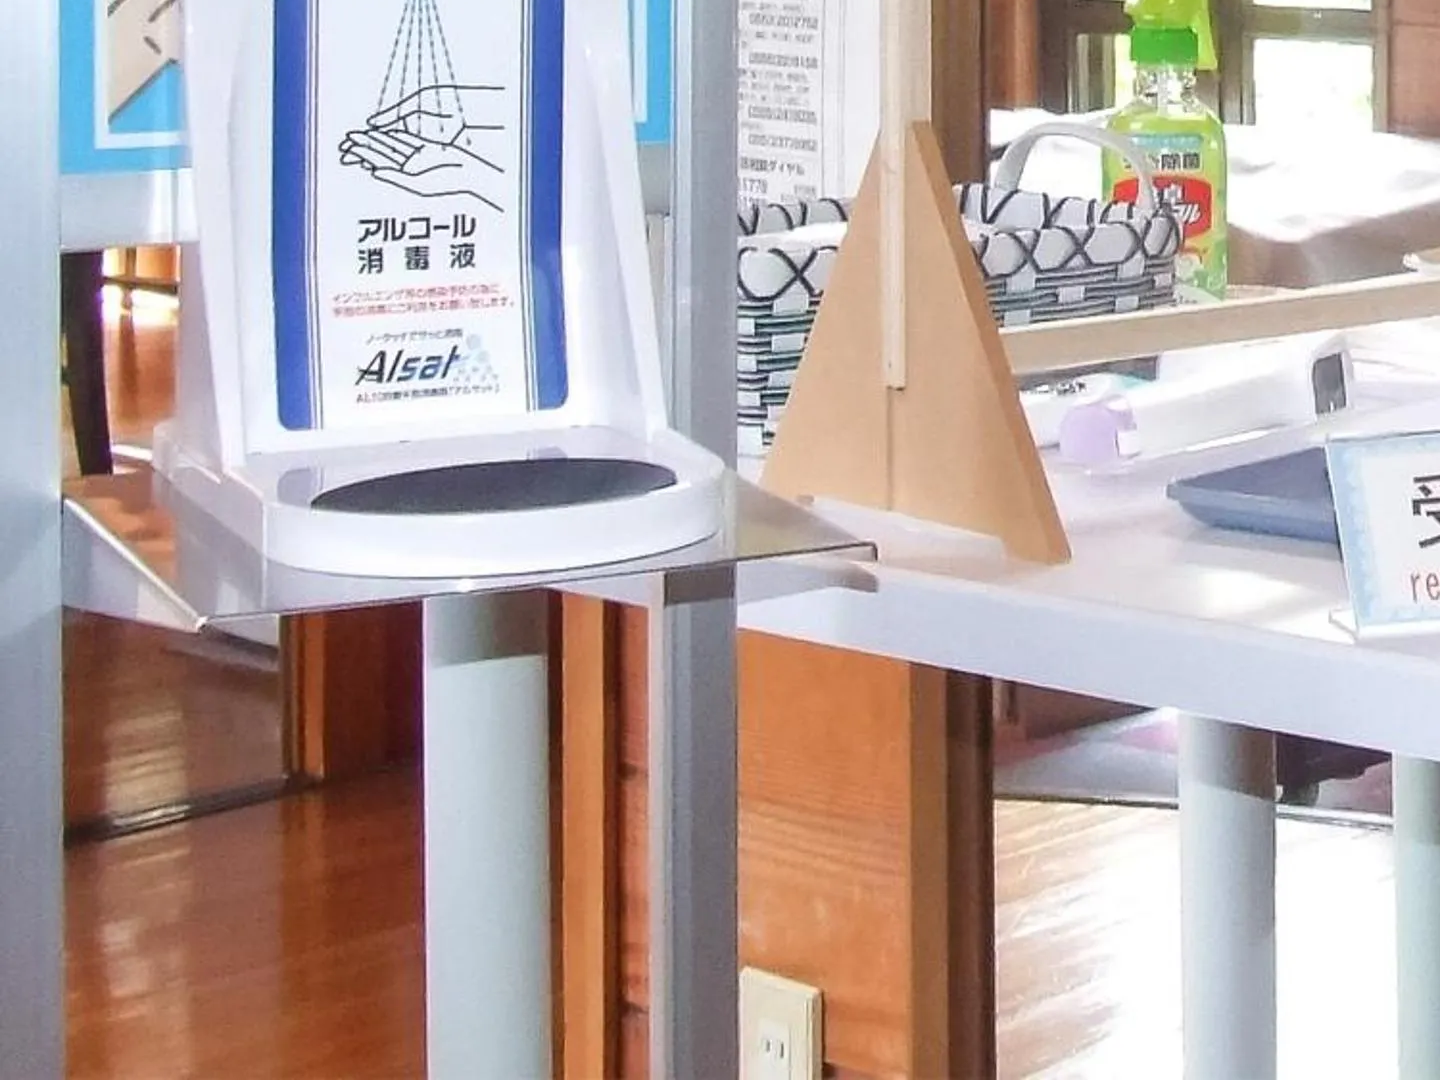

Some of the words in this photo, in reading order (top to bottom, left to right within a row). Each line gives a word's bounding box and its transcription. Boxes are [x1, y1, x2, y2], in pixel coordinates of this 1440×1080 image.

[357, 213, 478, 245] アルコール
[357, 242, 478, 275] 消毒液
[354, 344, 463, 386] Alsat
